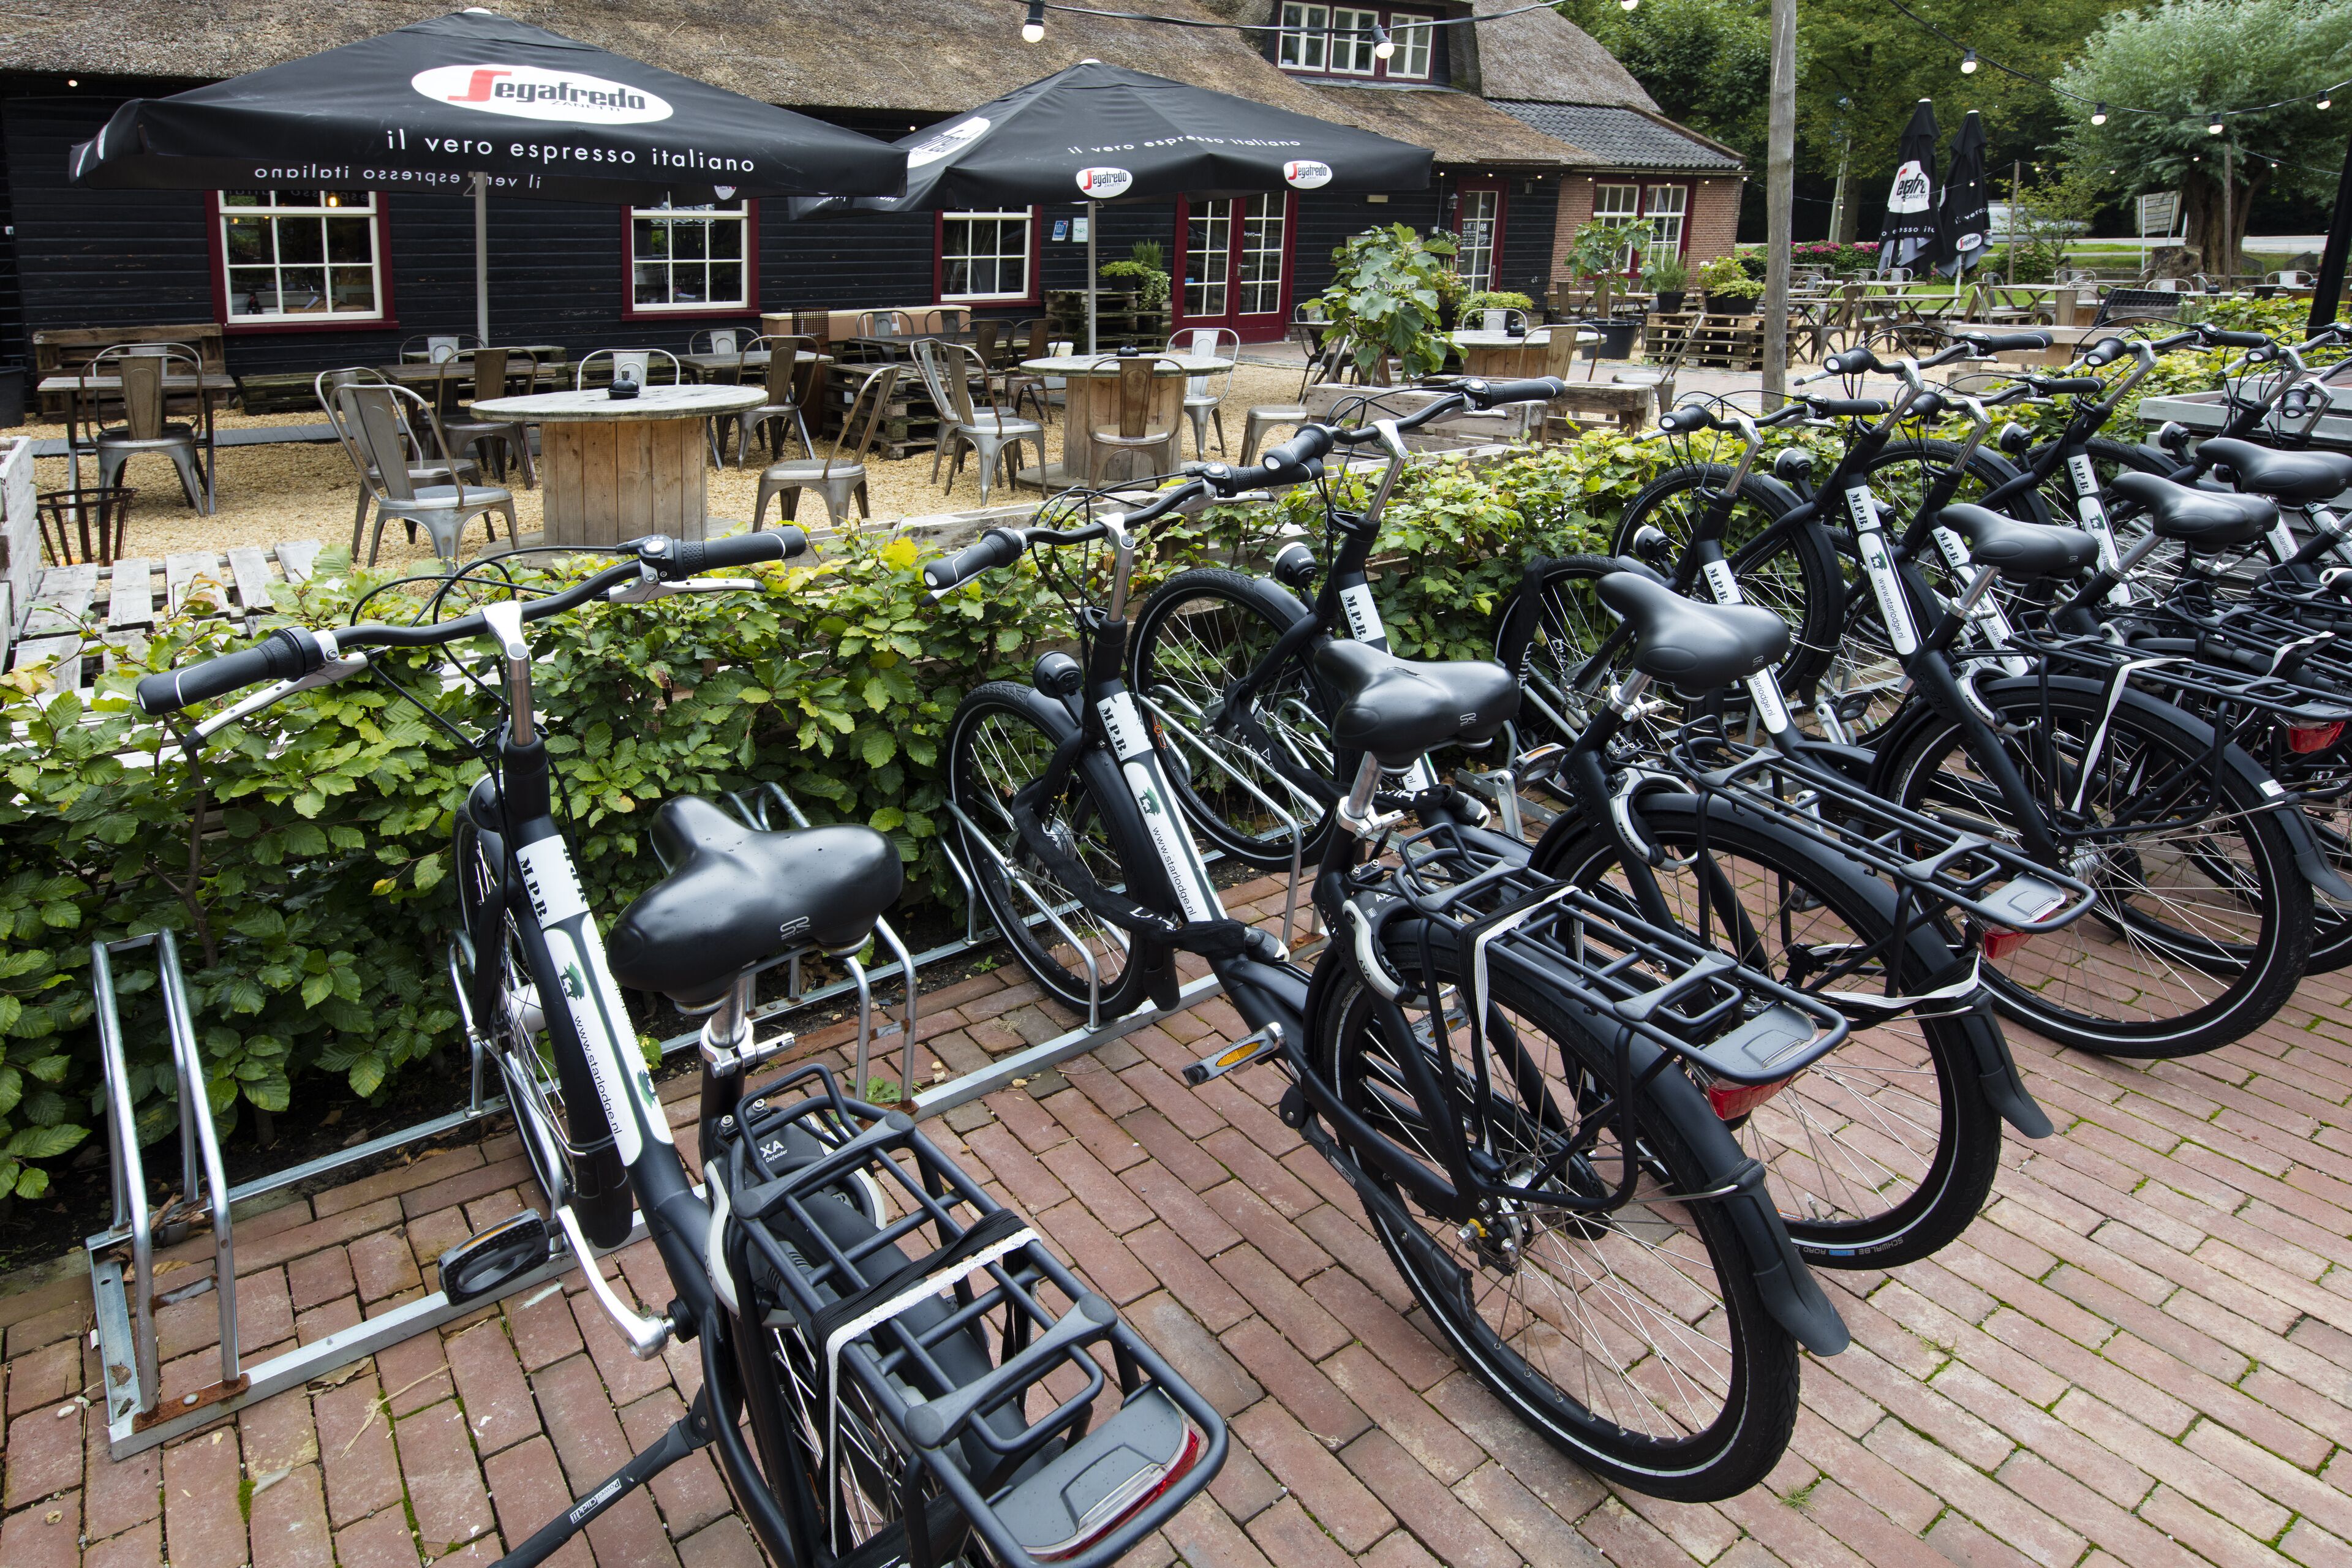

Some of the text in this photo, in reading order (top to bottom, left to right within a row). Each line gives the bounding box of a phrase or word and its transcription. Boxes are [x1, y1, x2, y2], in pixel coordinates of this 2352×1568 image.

[447, 69, 646, 110] Segafredo
[551, 100, 621, 111] ZANETTI
[387, 128, 755, 172] il vero espresso italiano
[1091, 143, 1134, 153] vero
[1144, 134, 1224, 148] espresso
[1230, 137, 1300, 147] italiano
[1083, 170, 1126, 190] Segafredo
[1287, 163, 1327, 180] Segafredo
[1850, 492, 1868, 527] M.P.B.
[1938, 532, 1959, 564] M.P.B.
[1708, 568, 1728, 603] M.P.B.
[1345, 594, 1366, 639] M.P.B.
[1878, 578, 1906, 639] www.starlodge.nl
[1753, 676, 1776, 717] tarlodge.nl
[1965, 694, 1991, 720] TRELOCK
[1102, 706, 1127, 756] M.P.B.
[1618, 821, 1647, 857] TRELOCK
[1153, 826, 1197, 916] www.starlodge.nl
[520, 856, 548, 923] M.P.B.
[1359, 960, 1371, 979] AXA
[1341, 981, 1362, 1008] SCHWALB
[575, 1015, 622, 1134] www.starlodge.nl
[760, 1140, 784, 1158] XA
[766, 1150, 788, 1163] Defender
[1803, 1246, 1826, 1255] ROAD
[1858, 1237, 1904, 1254] SCHWALBE
